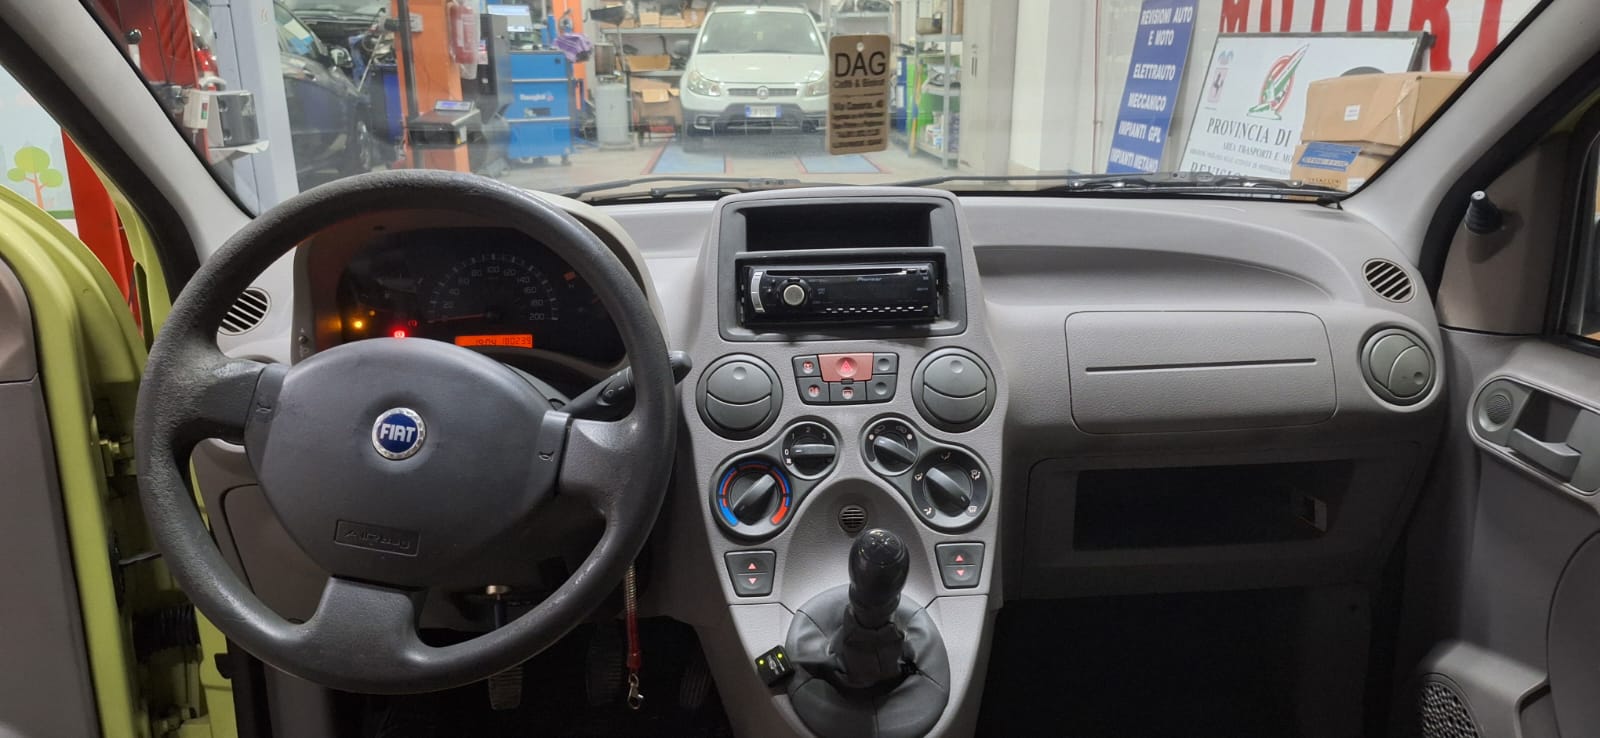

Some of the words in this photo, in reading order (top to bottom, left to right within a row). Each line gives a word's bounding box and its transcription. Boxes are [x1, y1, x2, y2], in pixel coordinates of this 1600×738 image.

[1141, 8, 1172, 25] REVISIONI
[1173, 6, 1193, 24] AUTO
[1148, 31, 1154, 46] E
[1155, 30, 1175, 46] MOTO
[834, 51, 886, 77] DAG
[1133, 63, 1176, 81] ELETTRAUTO
[1128, 92, 1167, 112] MECCANICO
[1118, 120, 1147, 142] IMPIANTI
[1148, 126, 1162, 144] GPL
[1206, 117, 1269, 144] PROVINCIA
[1275, 127, 1292, 148] DI
[1109, 148, 1135, 168] IMPIANTI
[529, 312, 545, 321] 200
[380, 424, 416, 443] FIAT
